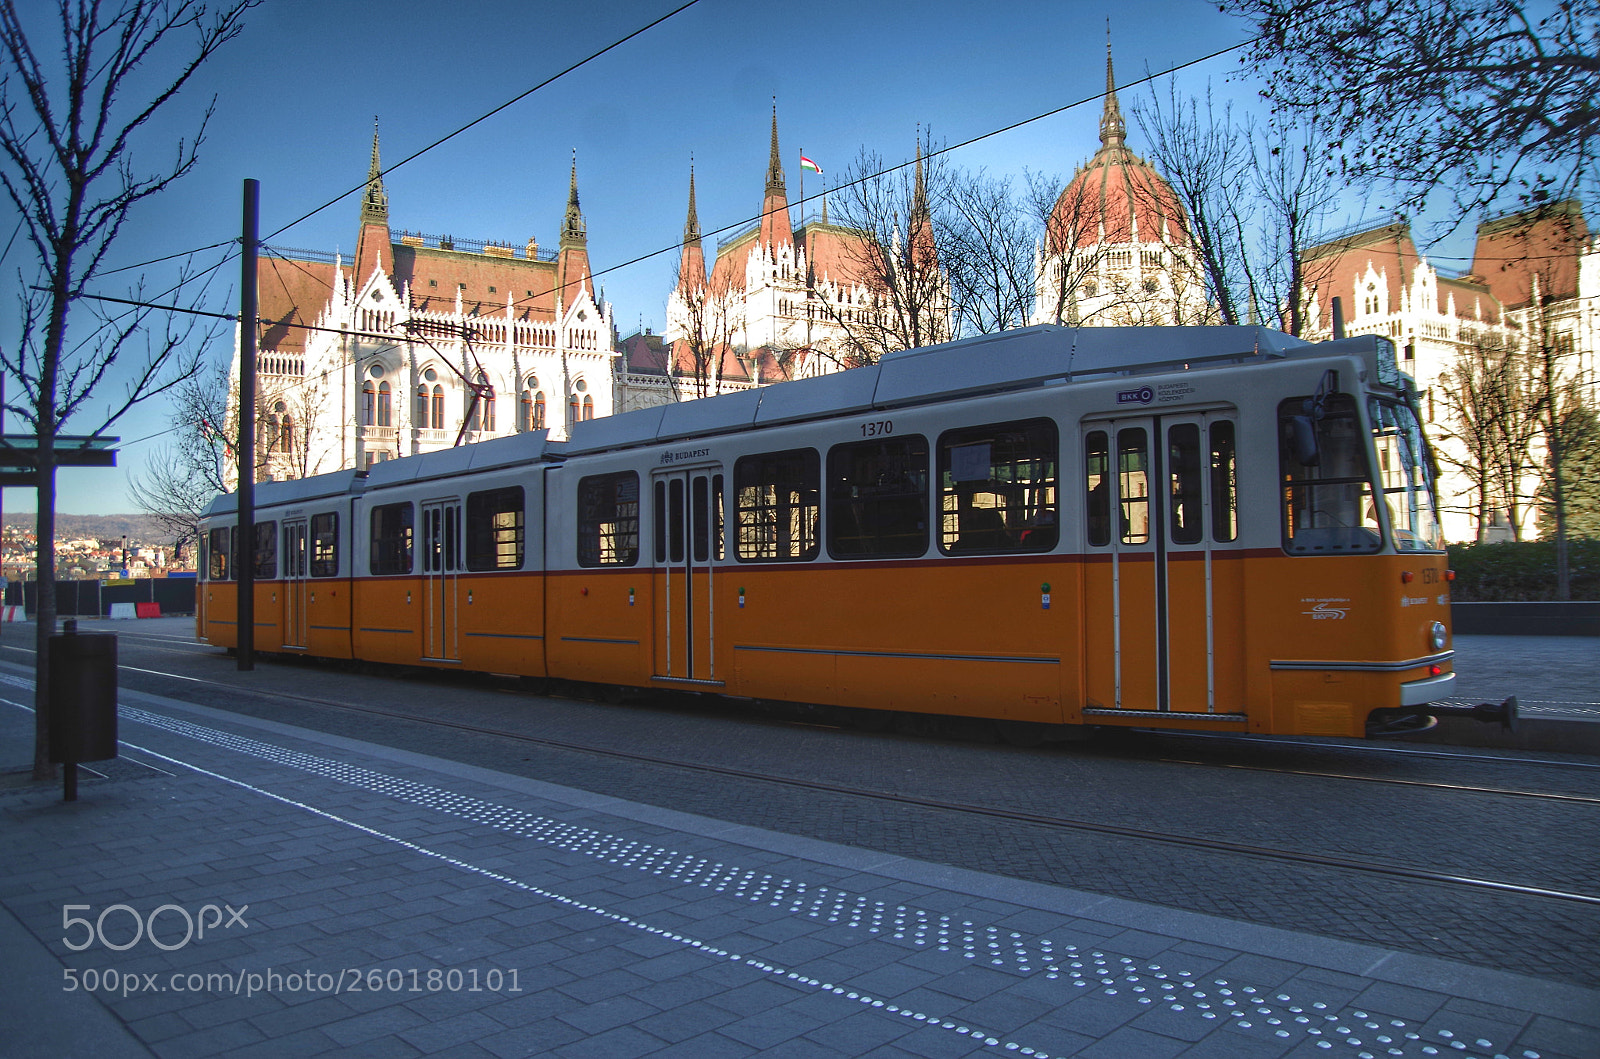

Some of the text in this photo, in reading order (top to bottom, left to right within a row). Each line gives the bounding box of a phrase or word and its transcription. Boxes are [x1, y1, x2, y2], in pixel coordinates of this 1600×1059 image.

[1121, 393, 1138, 401] BKK
[861, 420, 893, 437] 1370
[675, 448, 710, 460] BUDAPEST
